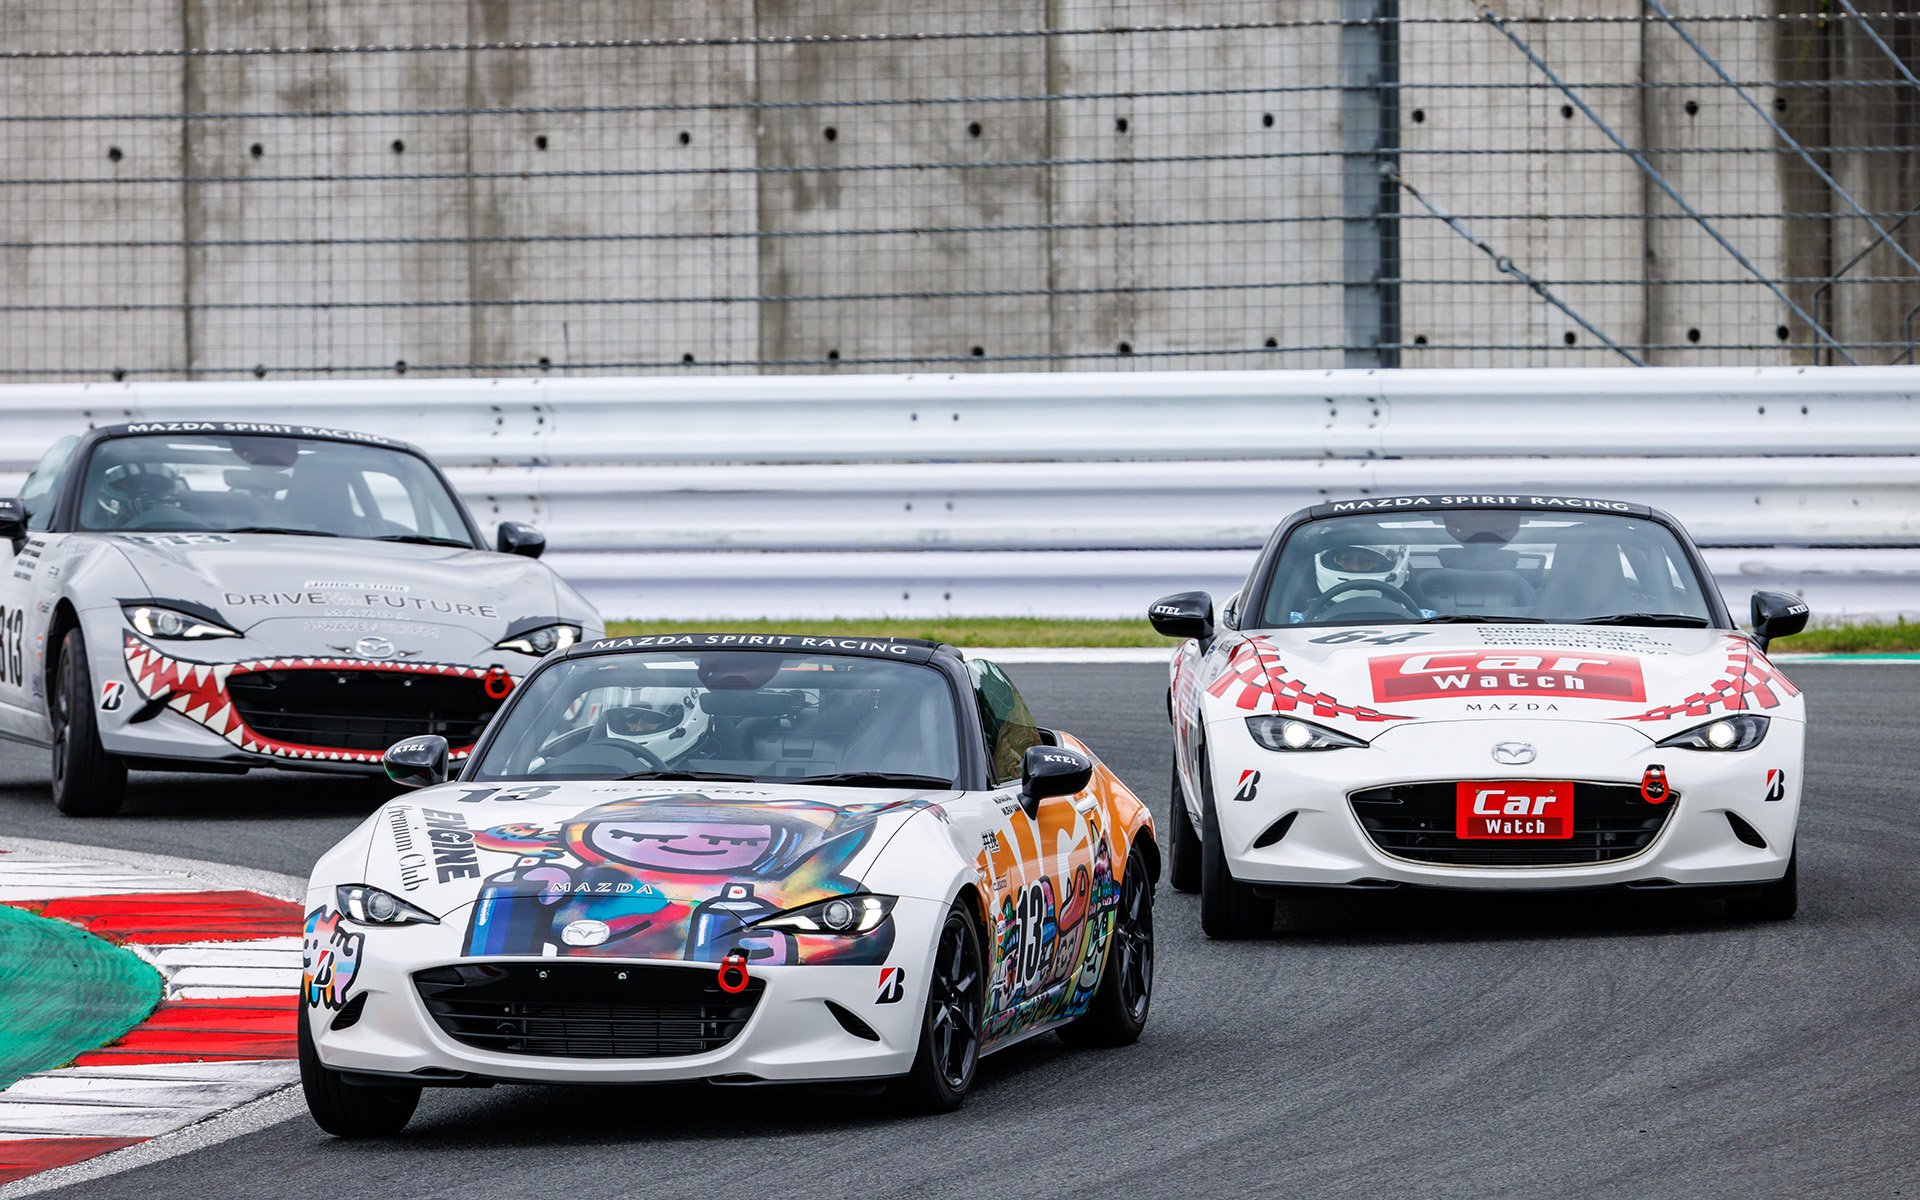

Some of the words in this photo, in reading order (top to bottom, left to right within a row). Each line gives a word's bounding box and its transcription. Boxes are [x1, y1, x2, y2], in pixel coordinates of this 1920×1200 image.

[128, 422, 216, 433] MAZDA
[222, 422, 293, 434] SPIRIT
[301, 427, 389, 444] RACING
[1333, 496, 1431, 512] MAZDA
[1440, 496, 1520, 504] SPIRIT
[1531, 497, 1629, 511] RACING
[224, 592, 327, 606] DRIVE
[364, 594, 498, 618] FUTURE
[1154, 605, 1181, 616] KTEL
[592, 635, 694, 650] MAZDA
[704, 635, 791, 645] SPIRIT
[801, 637, 908, 655] RACING
[1308, 630, 1434, 645] 64
[1399, 652, 1612, 675] Car
[1432, 673, 1585, 690] Watch
[1466, 703, 1559, 711] MAZDA
[393, 744, 426, 754] KTEL
[1043, 754, 1080, 766] KTEL
[457, 785, 561, 803] 13
[1473, 789, 1557, 815] Car
[387, 805, 419, 852] Premium
[1485, 819, 1545, 834] Watch
[421, 807, 482, 885] ENGINE
[399, 853, 429, 892] Club
[551, 882, 653, 895] MAZDA
[1016, 881, 1045, 988] 13
